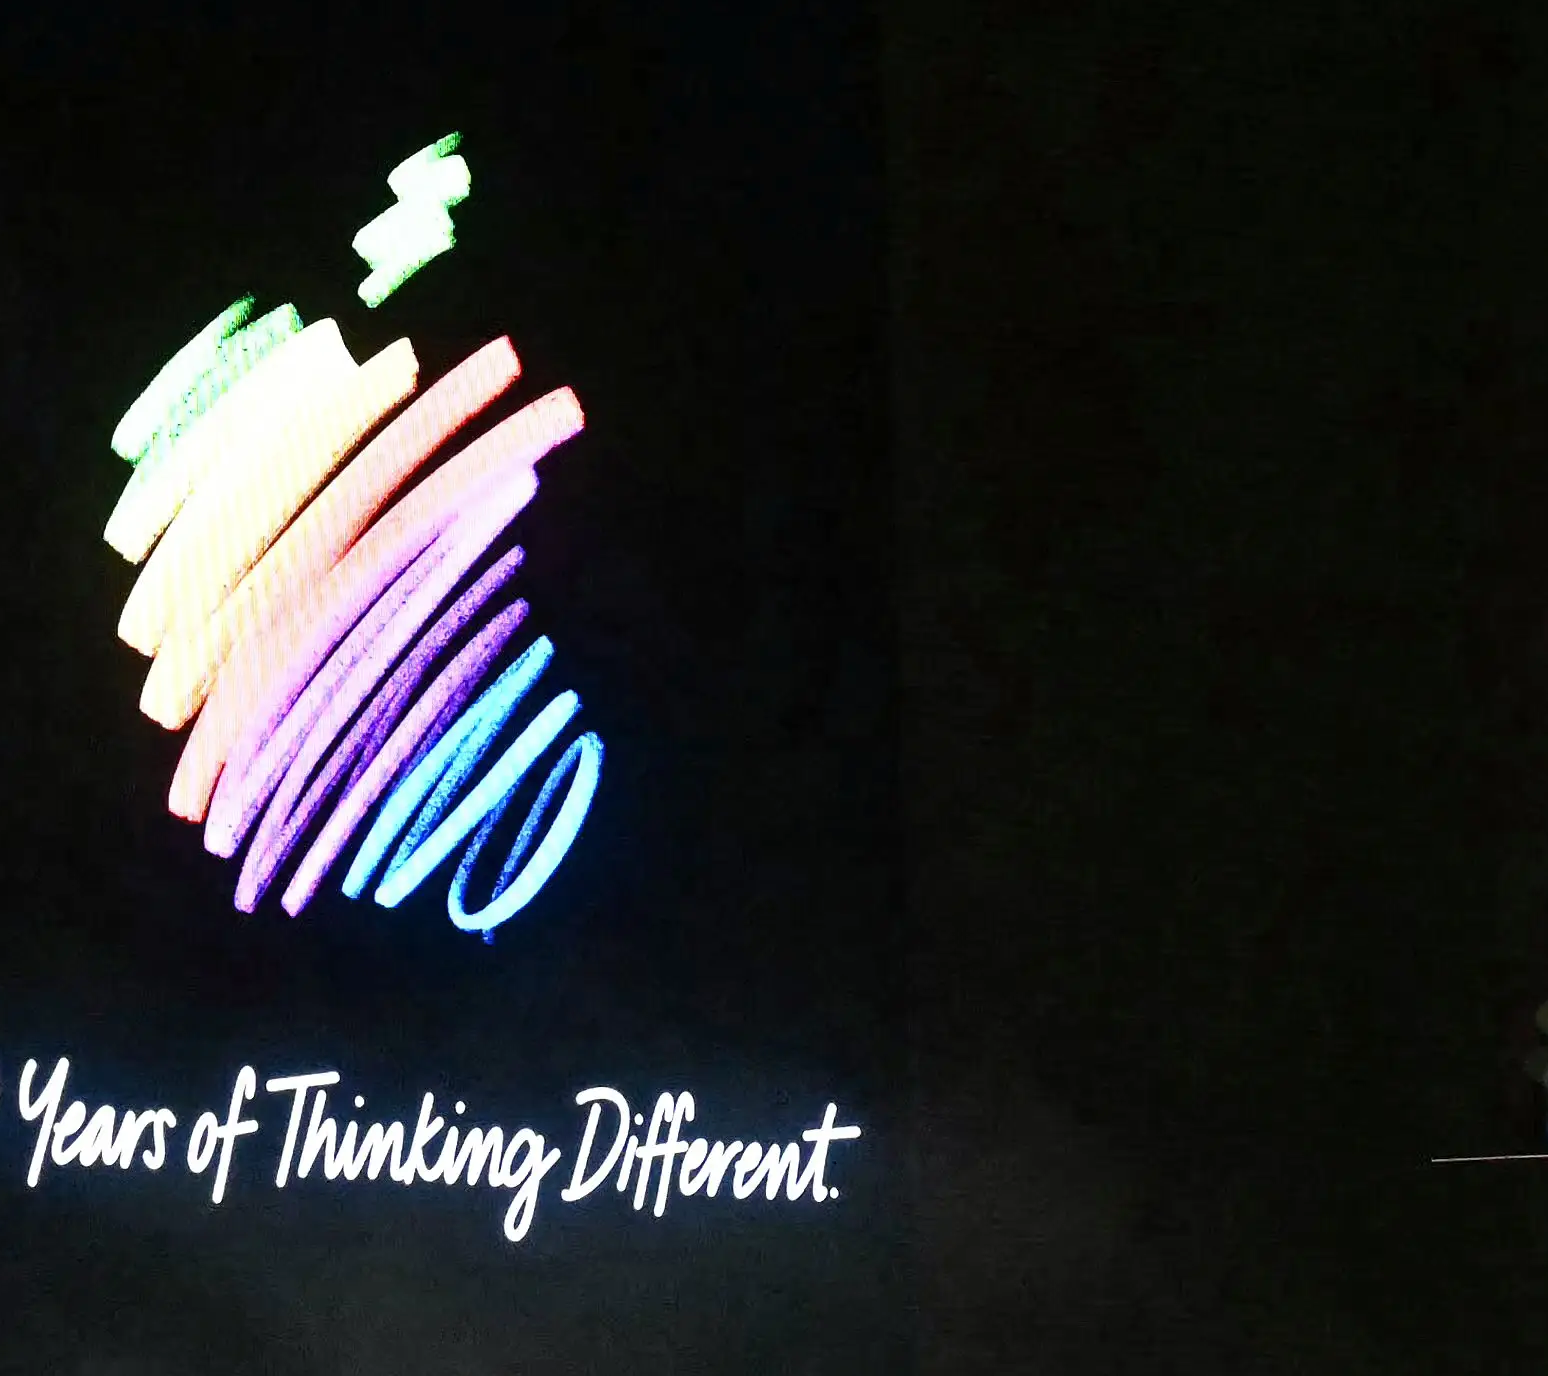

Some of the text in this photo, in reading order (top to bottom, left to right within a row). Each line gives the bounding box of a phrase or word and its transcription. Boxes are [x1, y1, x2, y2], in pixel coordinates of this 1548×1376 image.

[17, 1056, 178, 1189] Years
[185, 1064, 260, 1206] of
[264, 1069, 561, 1244] Thinking
[560, 1085, 863, 1219] Different.
